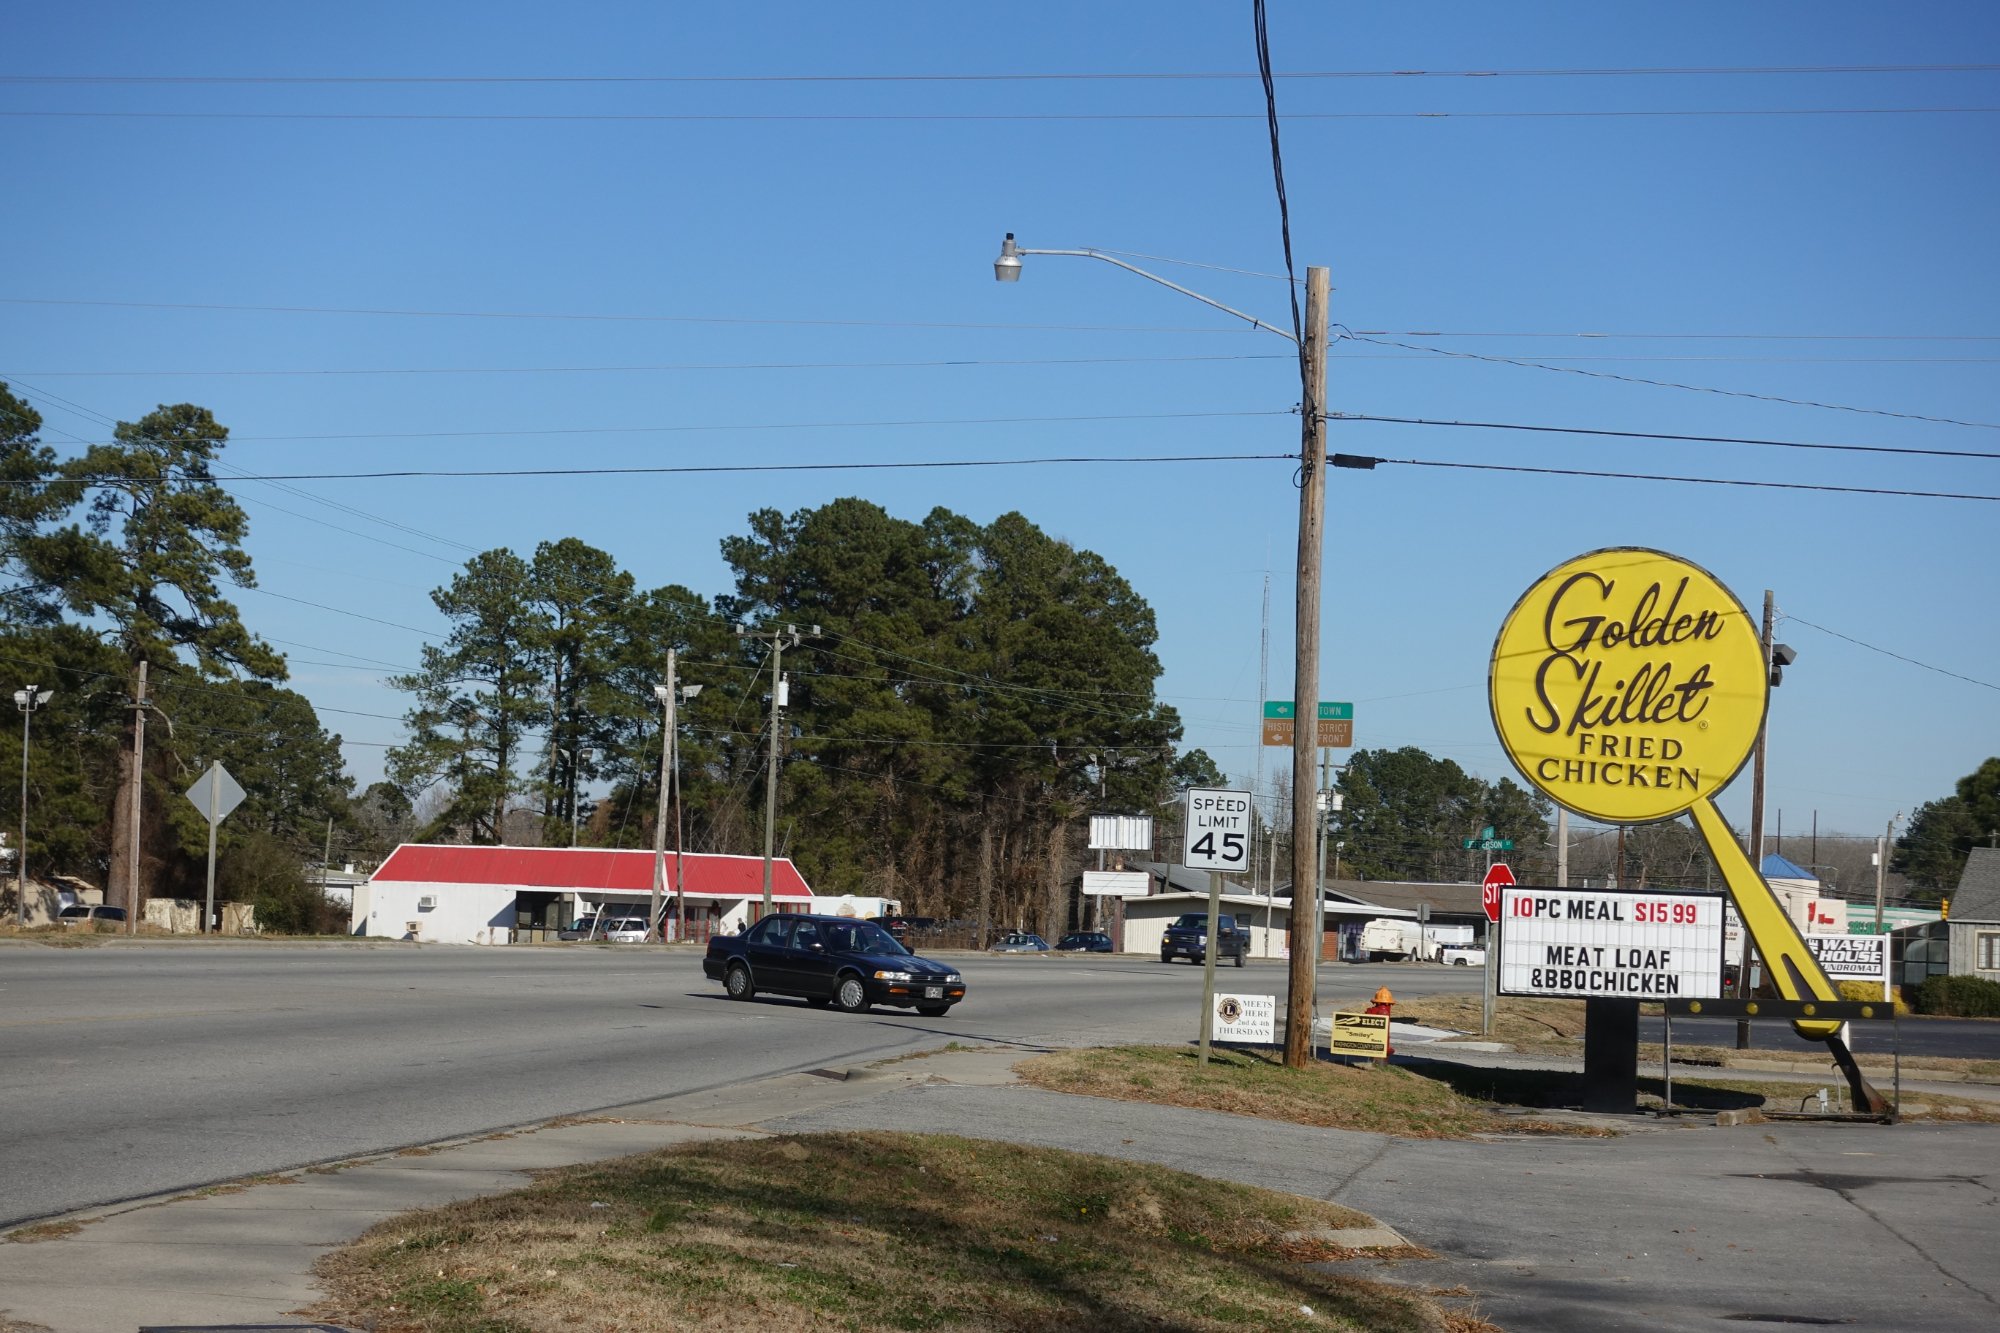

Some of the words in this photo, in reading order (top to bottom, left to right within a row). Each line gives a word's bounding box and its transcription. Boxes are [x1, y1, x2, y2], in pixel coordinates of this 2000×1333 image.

[1545, 572, 1724, 653] Golden
[1526, 652, 1714, 736] Skillet
[1267, 722, 1294, 732] HISTO
[1319, 723, 1348, 733] STRICT
[1579, 733, 1683, 760] FRIED
[1538, 758, 1700, 792] CHICKEN
[1193, 798, 1246, 812] SPEED
[1198, 815, 1239, 829] LIMIT
[1191, 832, 1244, 862] 45
[1567, 901, 1624, 921] MEAL
[1822, 939, 1877, 951] WASH
[1547, 946, 1604, 967] MEAT
[1615, 948, 1671, 969] LOAF
[1819, 950, 1881, 963] HOUSE
[1823, 963, 1879, 972] UNDROMAT
[1243, 1000, 1272, 1008] MEETS
[1361, 1018, 1384, 1026] ELECT
[1219, 1027, 1269, 1036] THURSDAYS
